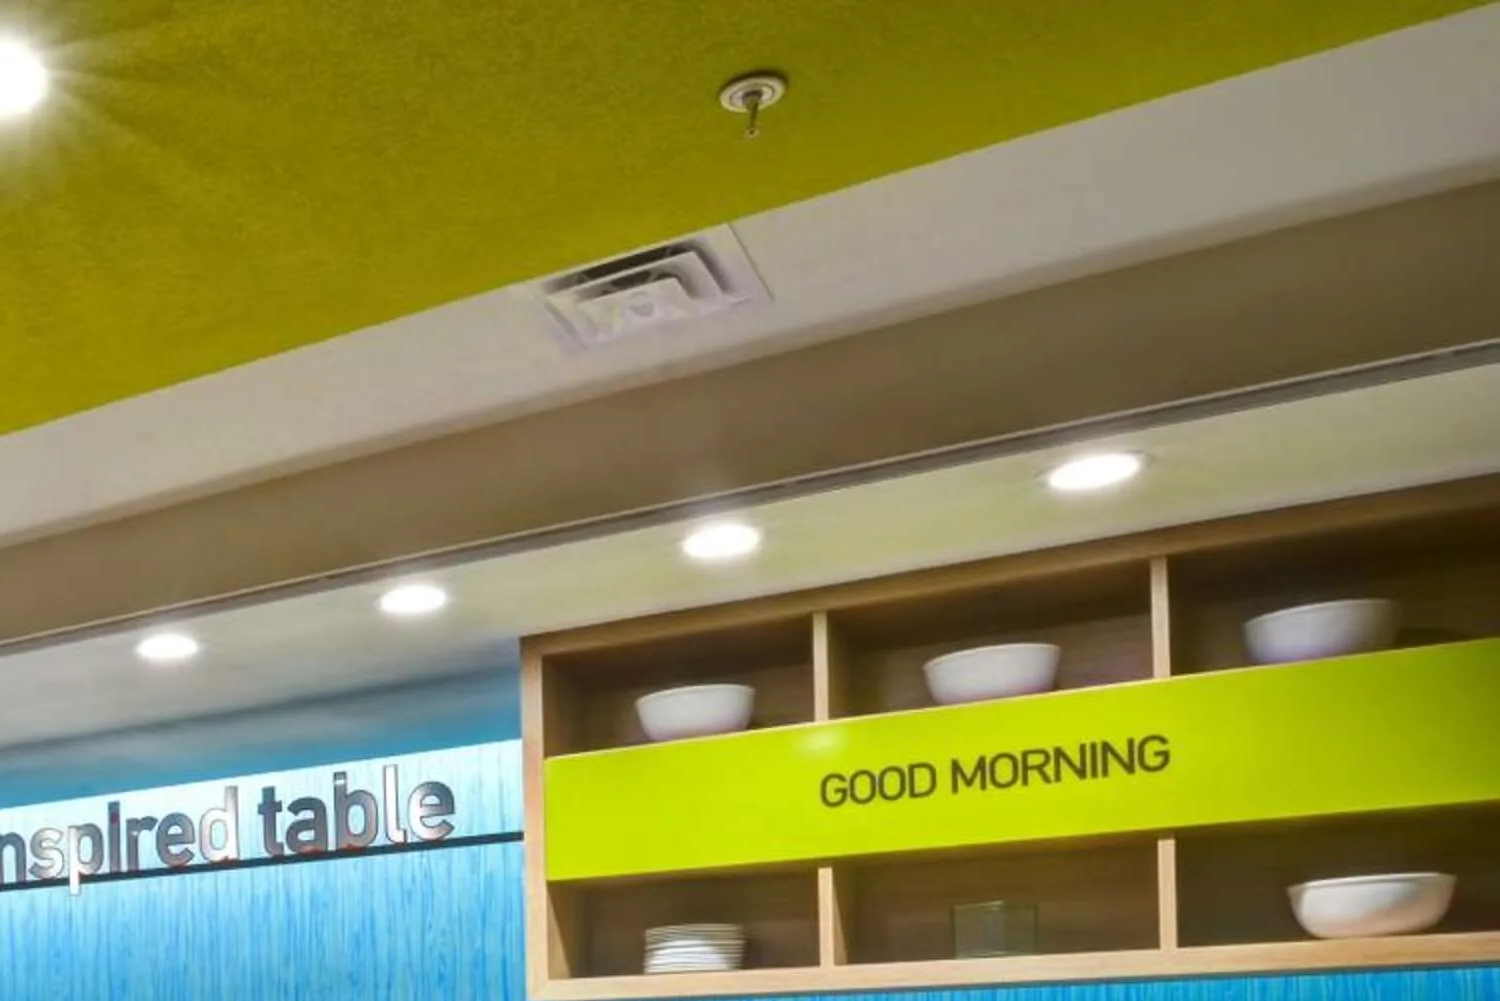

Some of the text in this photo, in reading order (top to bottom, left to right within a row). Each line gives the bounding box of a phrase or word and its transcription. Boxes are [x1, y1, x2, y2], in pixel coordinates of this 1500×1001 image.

[256, 764, 456, 859] table
[820, 734, 1171, 808] GOOD MORNING
